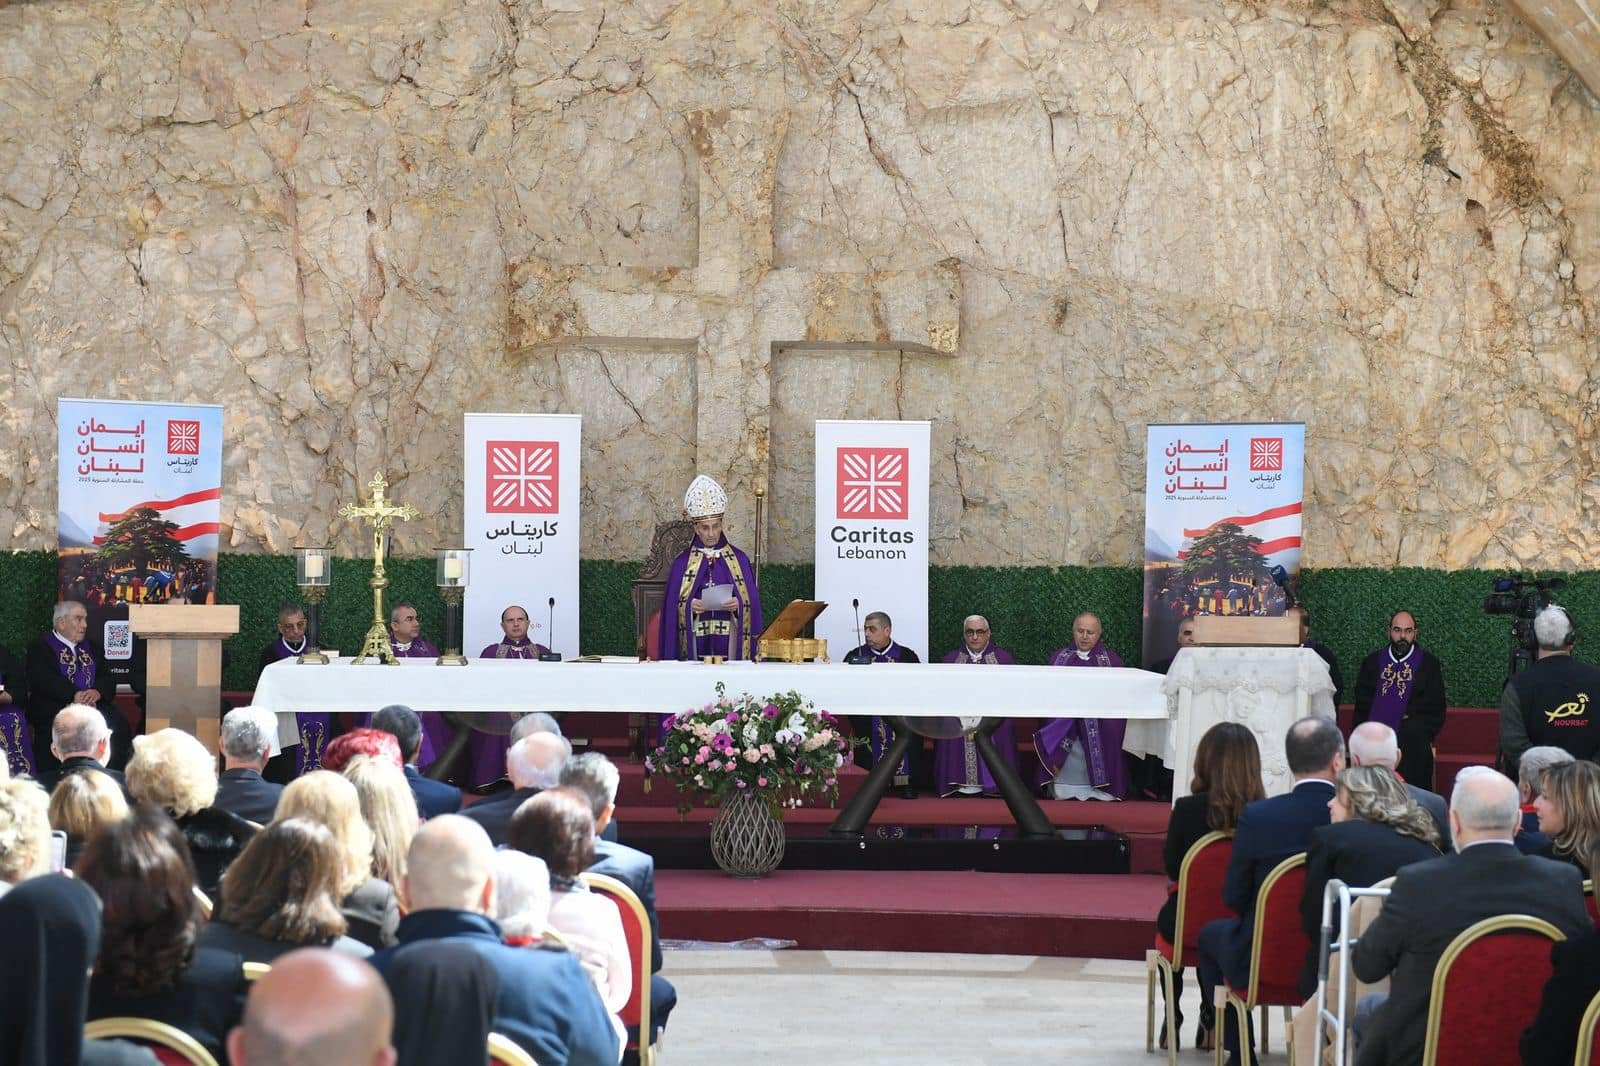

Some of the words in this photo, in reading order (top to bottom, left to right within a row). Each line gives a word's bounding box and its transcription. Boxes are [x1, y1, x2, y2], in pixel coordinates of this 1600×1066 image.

[77, 436, 145, 455] انسان
[77, 456, 144, 476] لبنان
[167, 457, 199, 467] كاريتاس
[1164, 457, 1229, 475] انسان
[1164, 475, 1227, 494] لبنان
[1249, 473, 1282, 483] كاريتاس
[486, 520, 559, 540] كاريتاس
[830, 526, 914, 544] Caritas
[501, 540, 543, 558] لبنان
[837, 545, 907, 560] Lebanon
